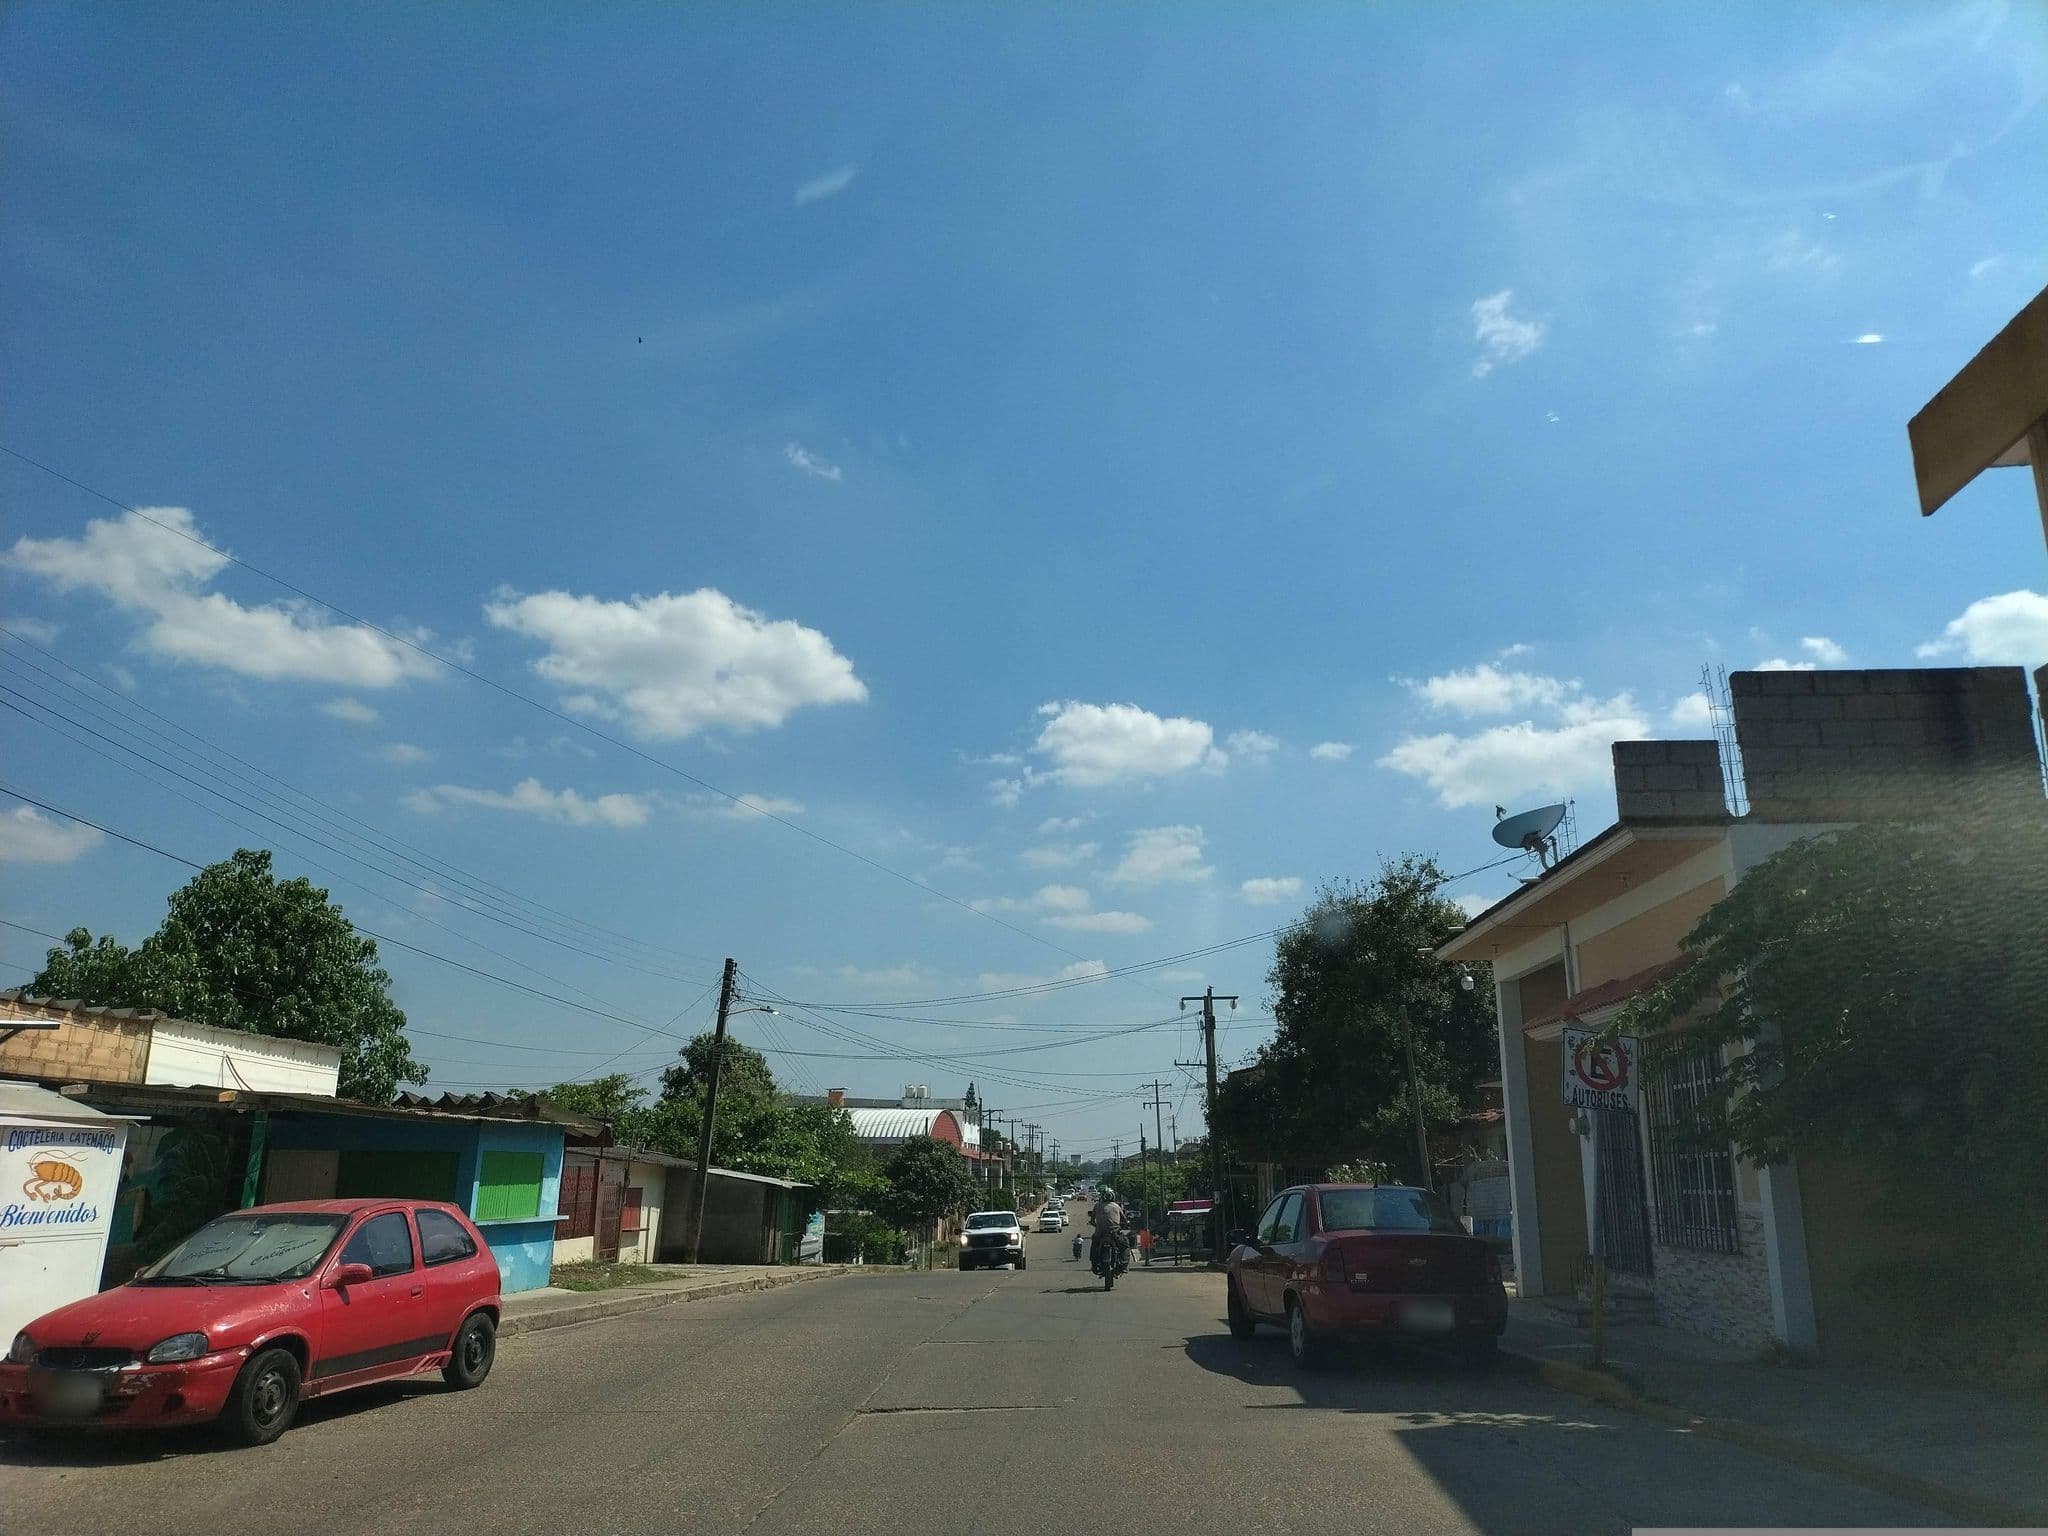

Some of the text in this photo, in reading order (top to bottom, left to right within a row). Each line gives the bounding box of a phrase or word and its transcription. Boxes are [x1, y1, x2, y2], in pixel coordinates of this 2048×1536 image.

[1571, 1086, 1629, 1110] AUTOBUSES
[8, 1129, 116, 1155] COCTELERIA CATEMACO
[0, 1202, 100, 1231] Bienvenidos
